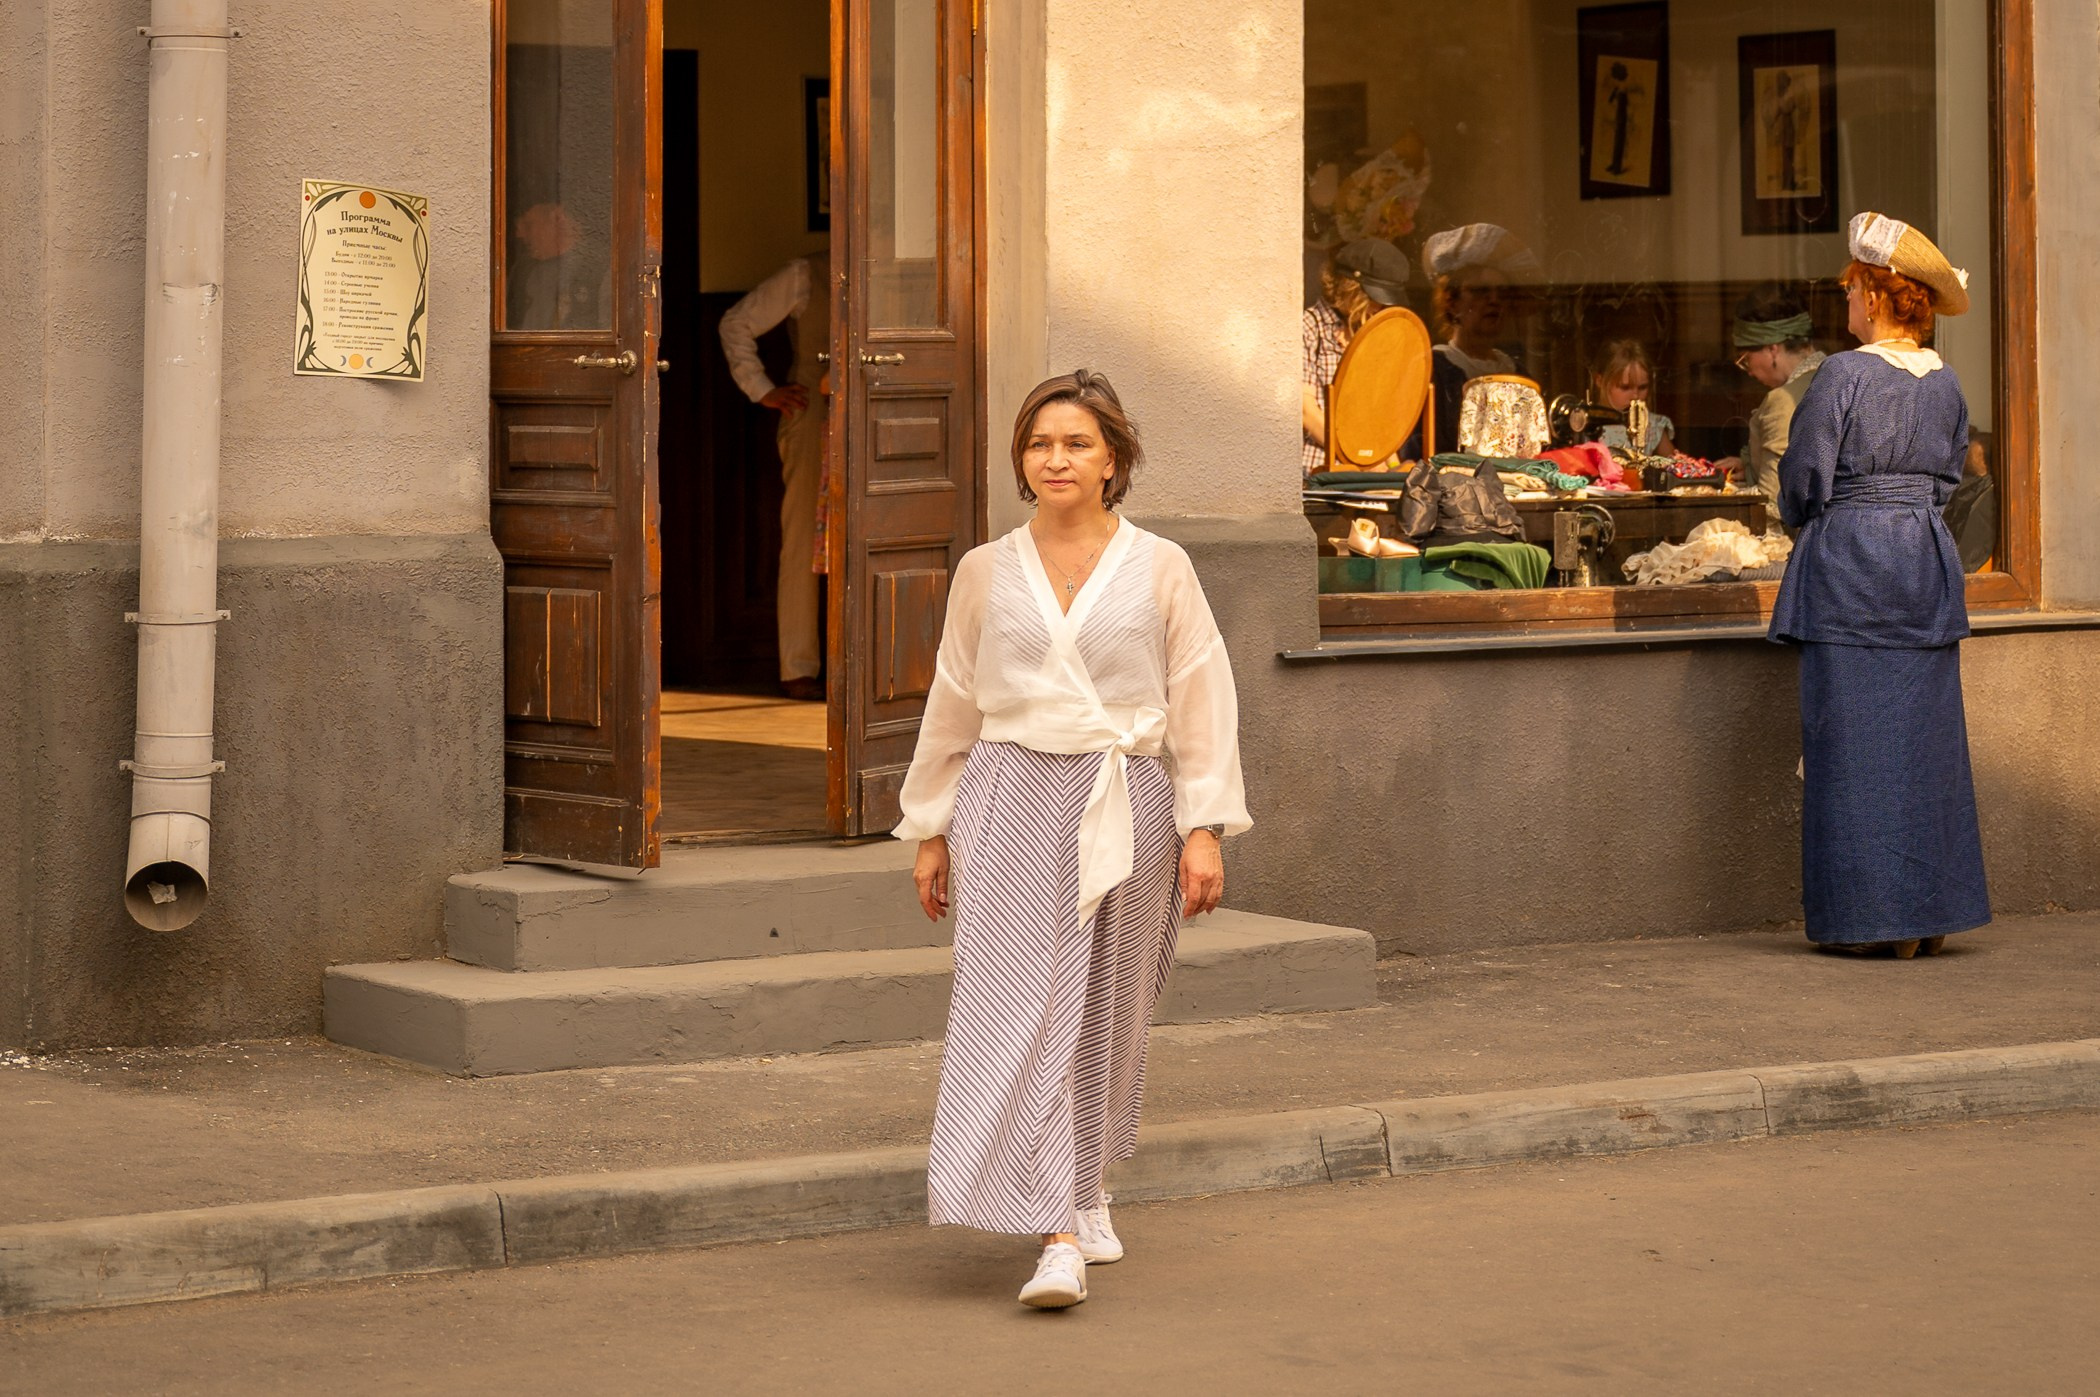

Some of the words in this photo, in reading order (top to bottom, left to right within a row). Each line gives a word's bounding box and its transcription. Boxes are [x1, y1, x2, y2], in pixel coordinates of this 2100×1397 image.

[341, 211, 391, 226] Программа
[339, 227, 369, 235] улицах
[371, 225, 403, 243] Москвы
